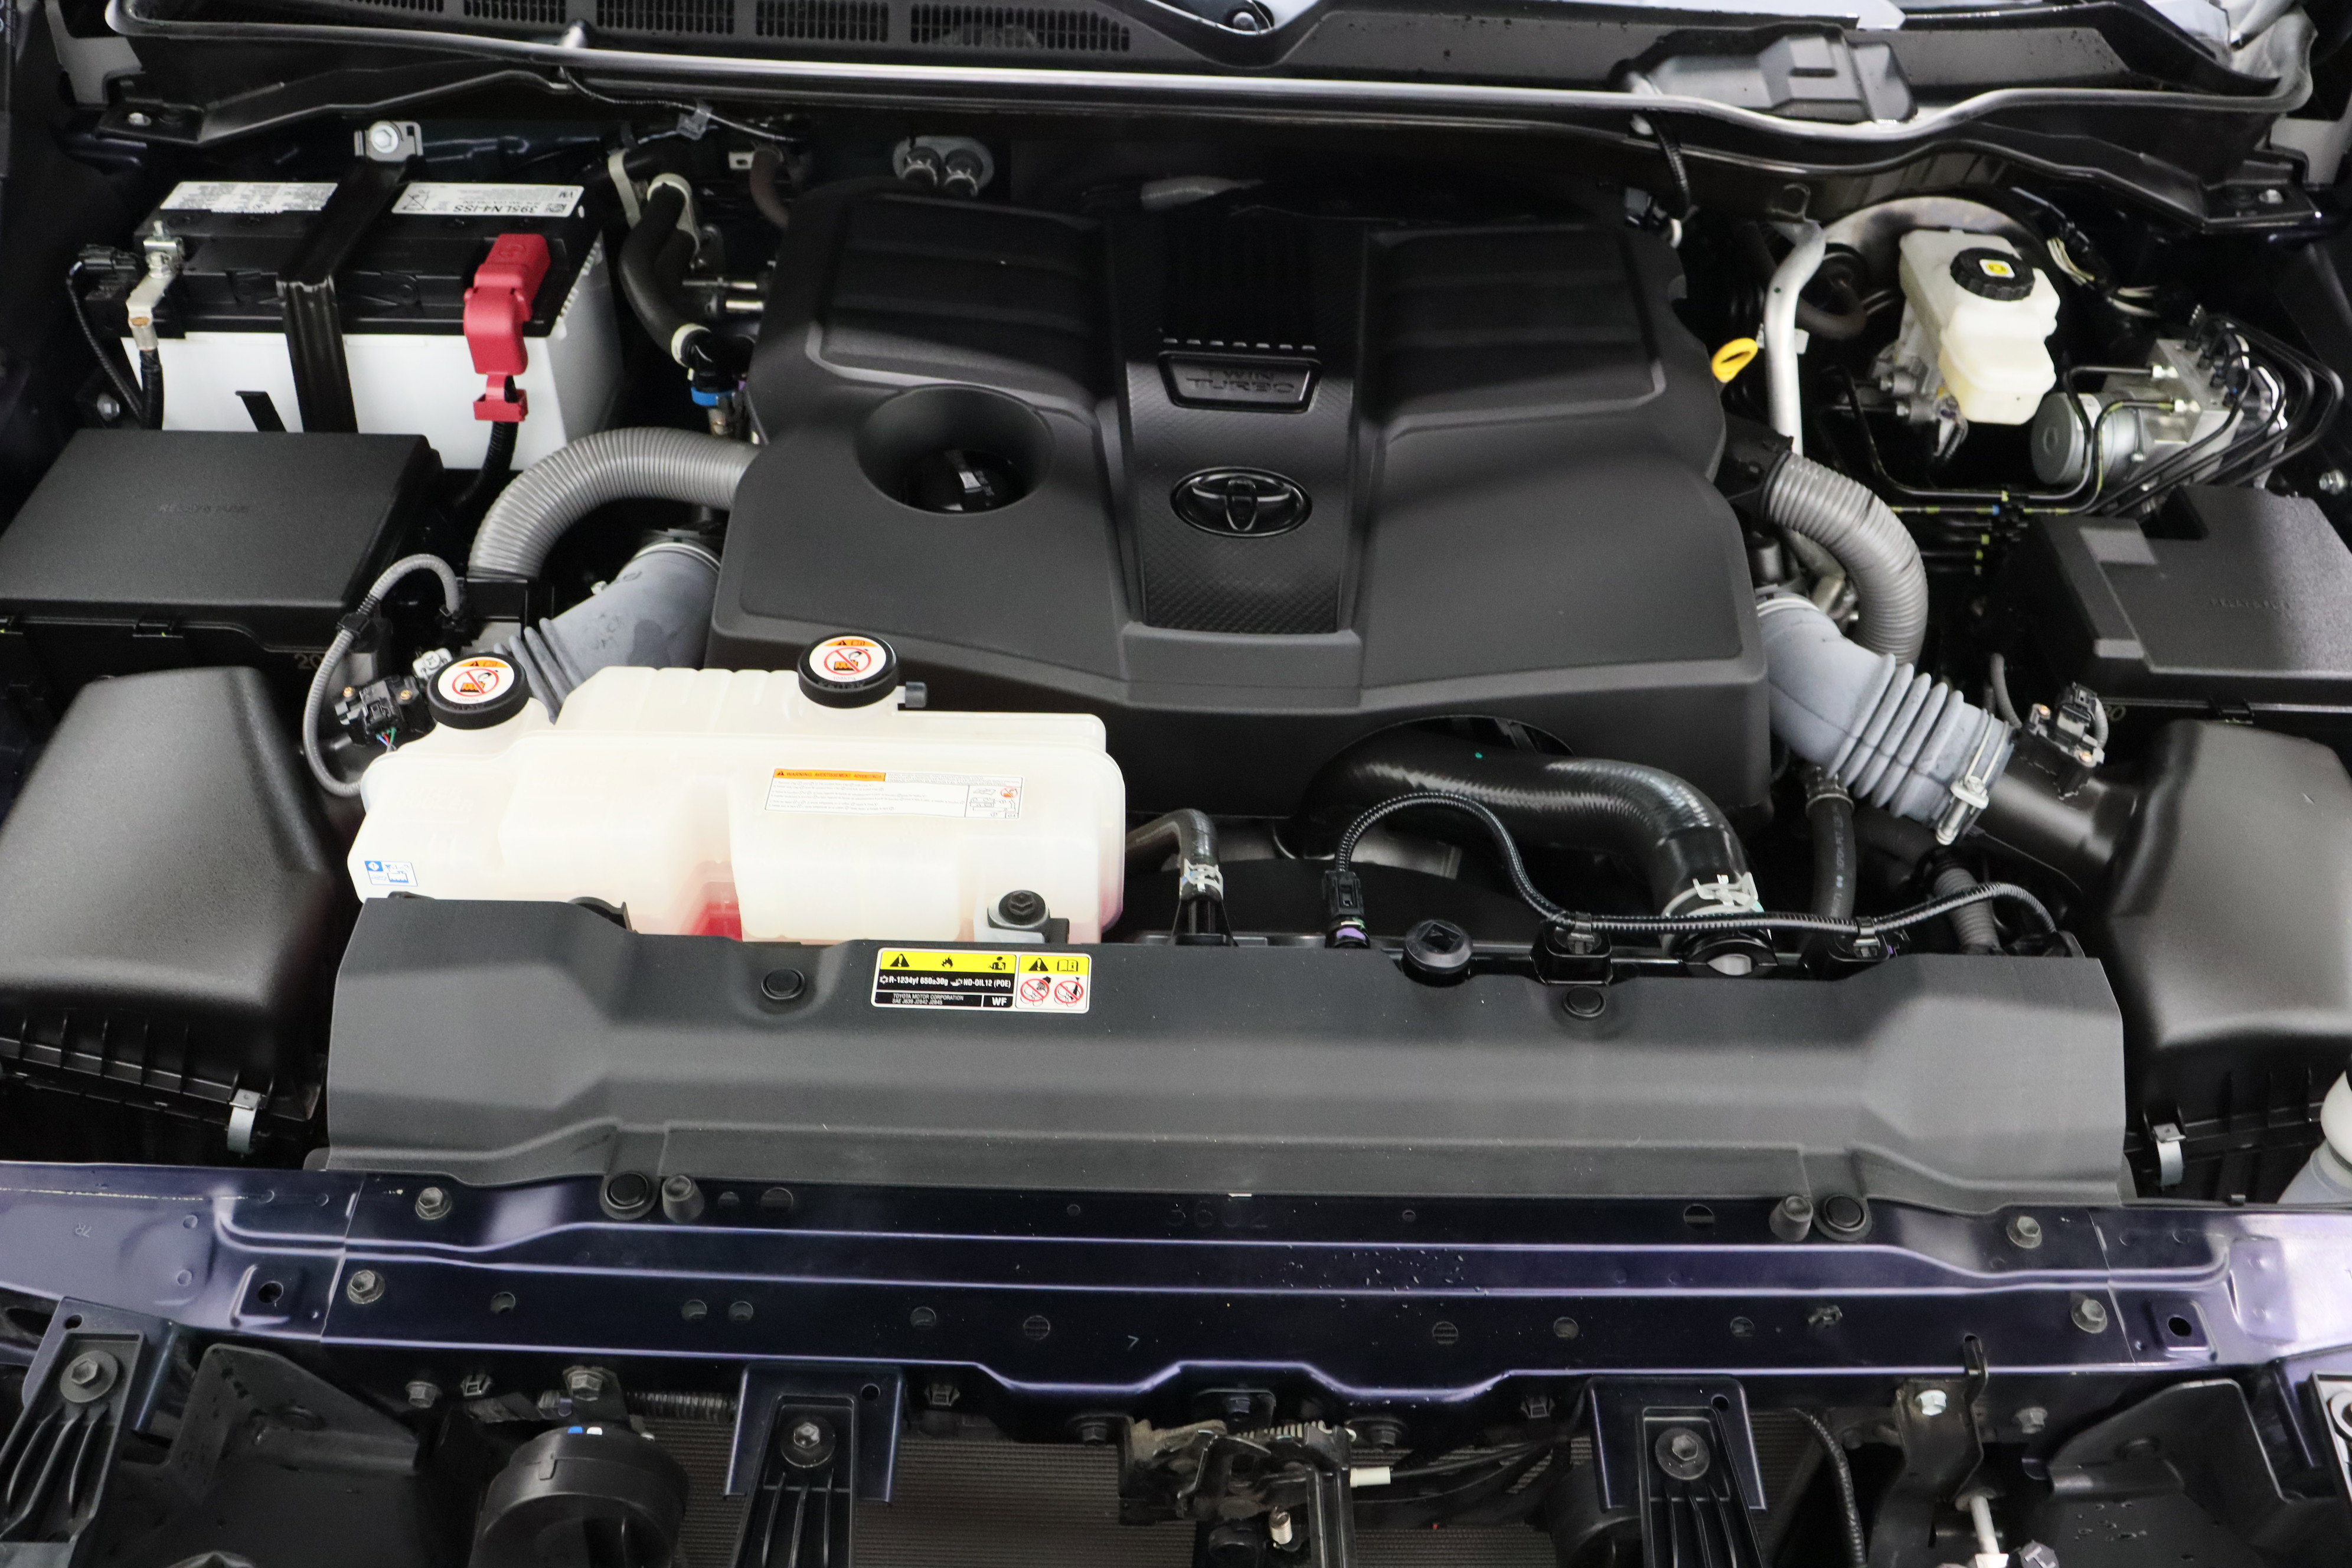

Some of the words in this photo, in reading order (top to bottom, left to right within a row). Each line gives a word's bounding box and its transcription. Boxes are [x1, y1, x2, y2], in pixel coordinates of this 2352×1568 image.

[1185, 377, 1295, 394] TURBO
[888, 975, 919, 986] R-1234yf
[994, 979, 1011, 989] (POE)
[991, 997, 1007, 1006] WF
